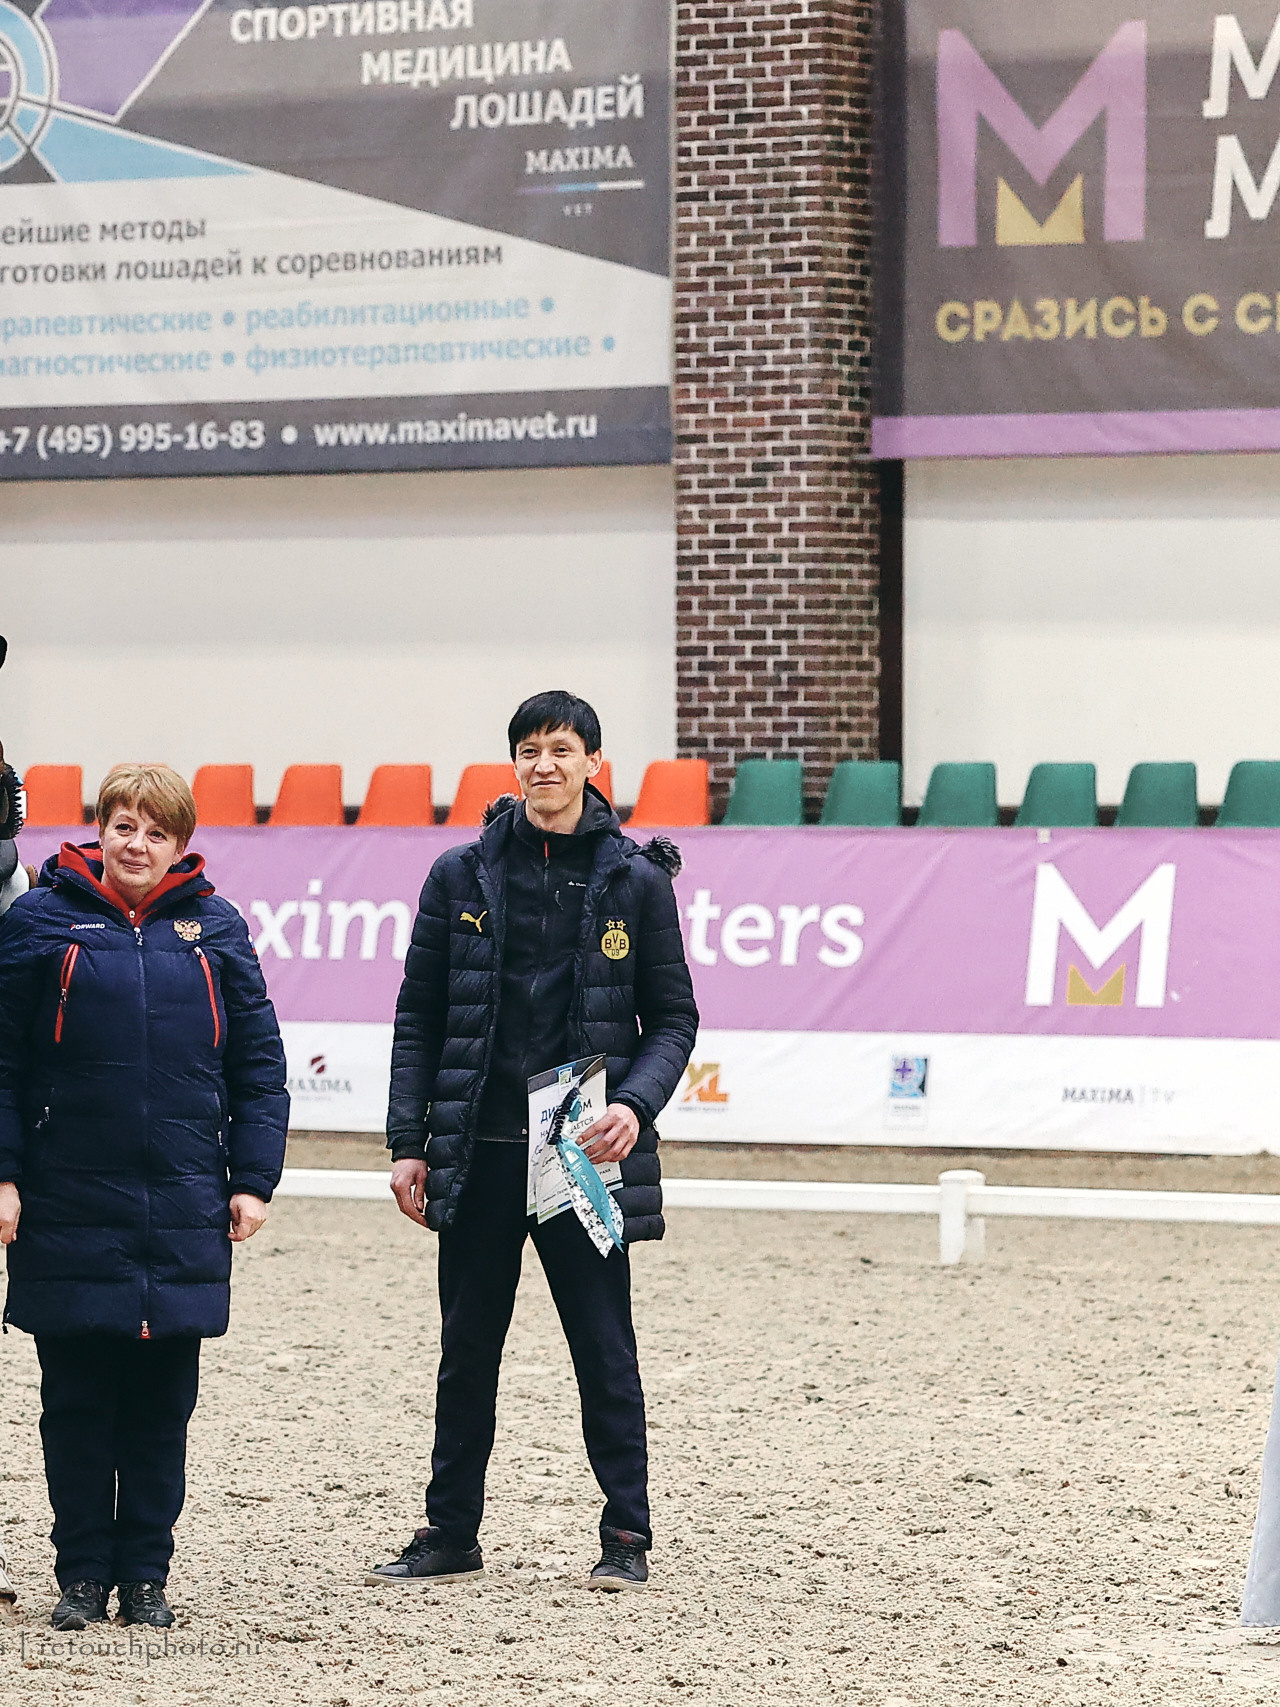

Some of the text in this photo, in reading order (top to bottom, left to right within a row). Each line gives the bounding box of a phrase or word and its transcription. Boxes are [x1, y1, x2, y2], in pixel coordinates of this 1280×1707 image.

[230, 0, 474, 43] СПОРТИВНАЯ
[361, 38, 573, 88] МЕДИЦИНА
[449, 74, 645, 131] ЛОШАДЕЙ
[524, 144, 635, 174] MAXIMA
[99, 217, 207, 244] методы
[114, 249, 243, 284] лошадей
[252, 254, 267, 276] к
[276, 242, 504, 282] соревнованиям
[245, 294, 531, 336] реабилитационные
[935, 291, 1280, 342] СРАЗИСЬ С С
[245, 332, 591, 374] физиотерапевтические
[36, 420, 113, 459] (495)
[119, 420, 267, 453] 995-16-83
[313, 410, 599, 447] www.maximavet.ru
[70, 923, 106, 931] FORWARD
[242, 879, 866, 968] xim ters
[604, 933, 627, 949] BVB
